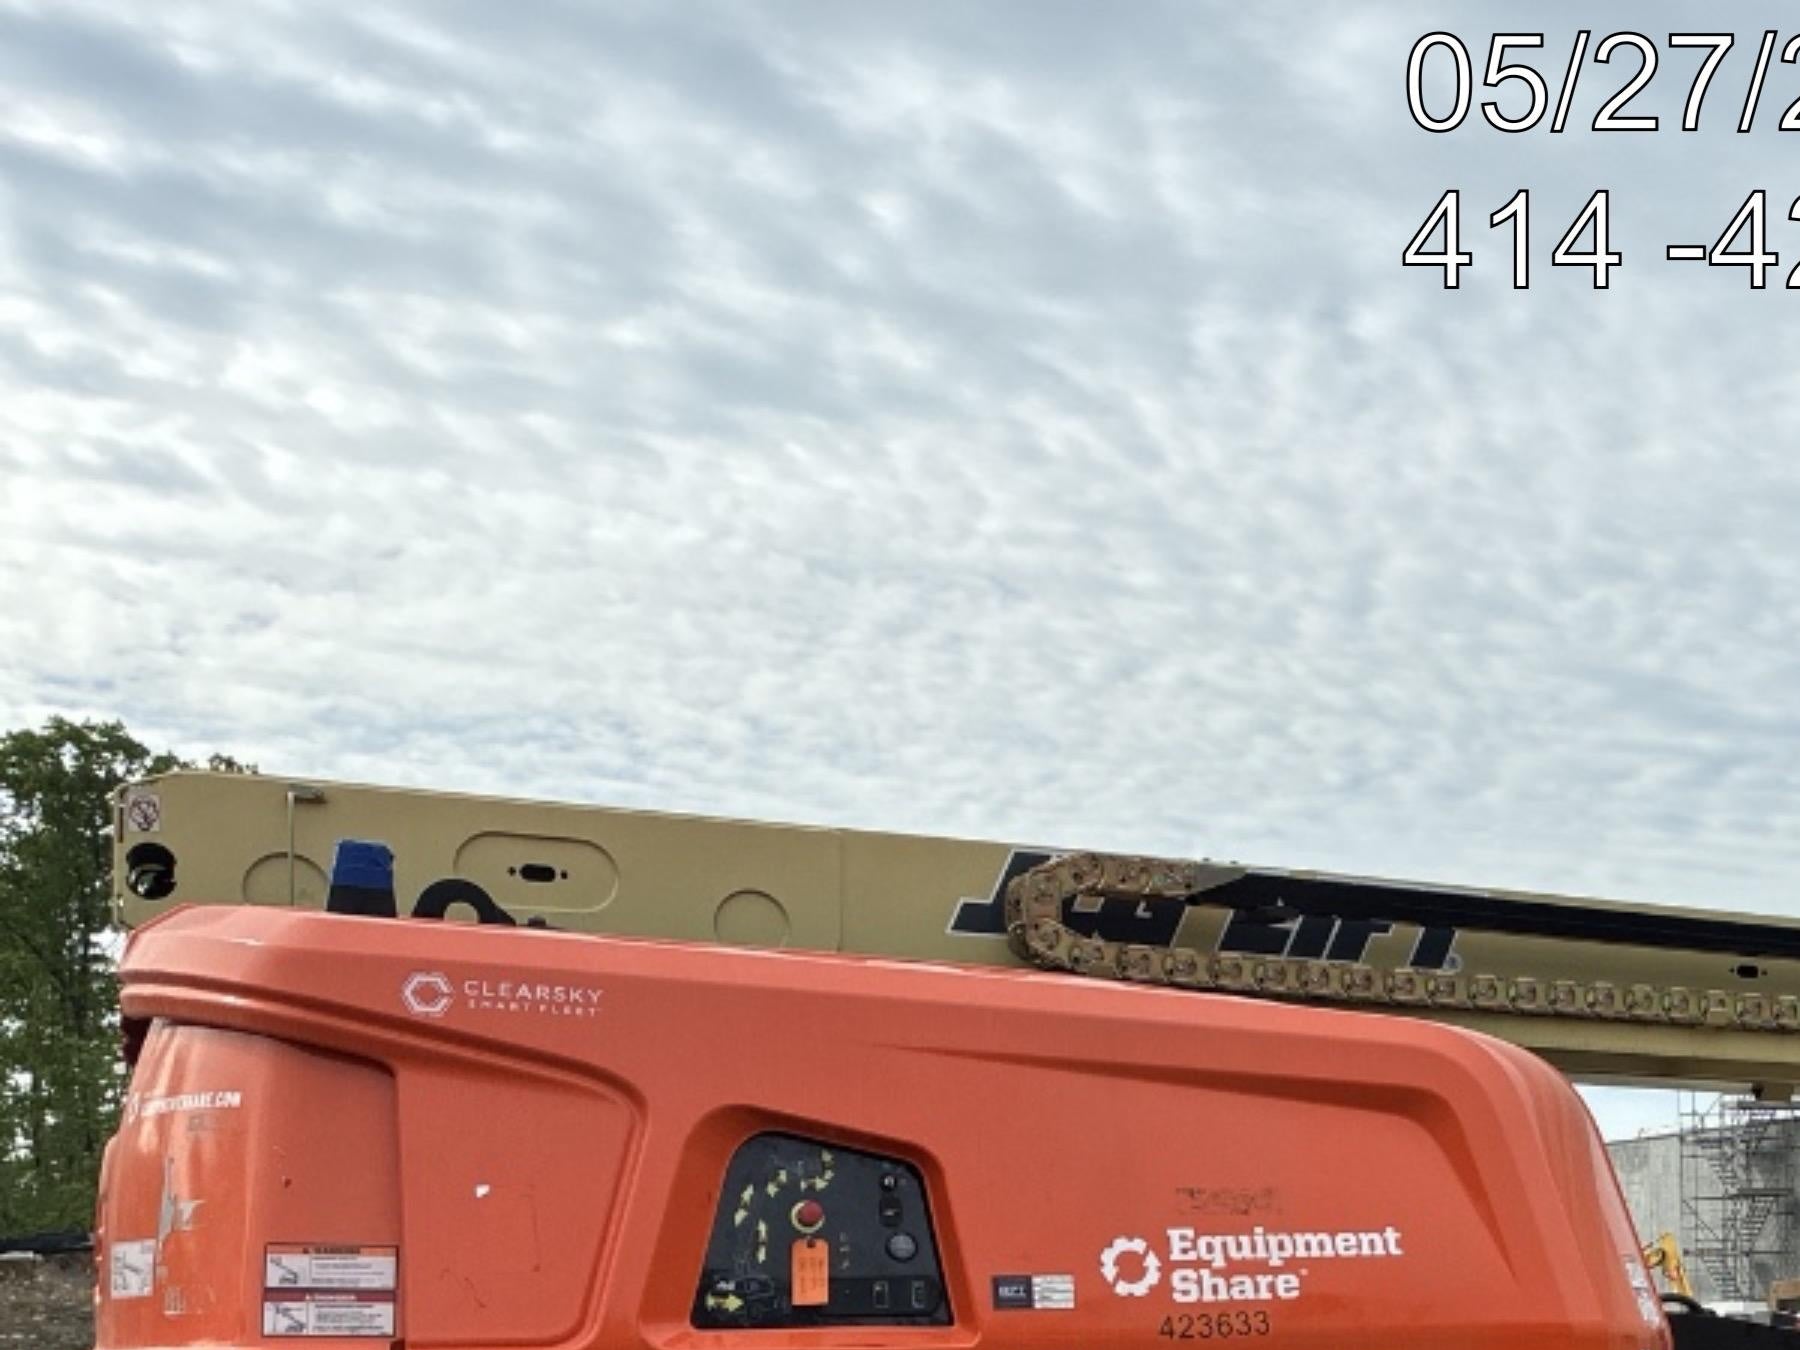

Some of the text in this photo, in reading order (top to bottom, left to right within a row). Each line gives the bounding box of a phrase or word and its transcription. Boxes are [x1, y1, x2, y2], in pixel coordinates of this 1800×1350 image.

[463, 979, 604, 1004] CLEARSKY
[1166, 1226, 1404, 1268] Equipment
[1171, 1267, 1301, 1303] Share
[1158, 1311, 1271, 1340] 423633
